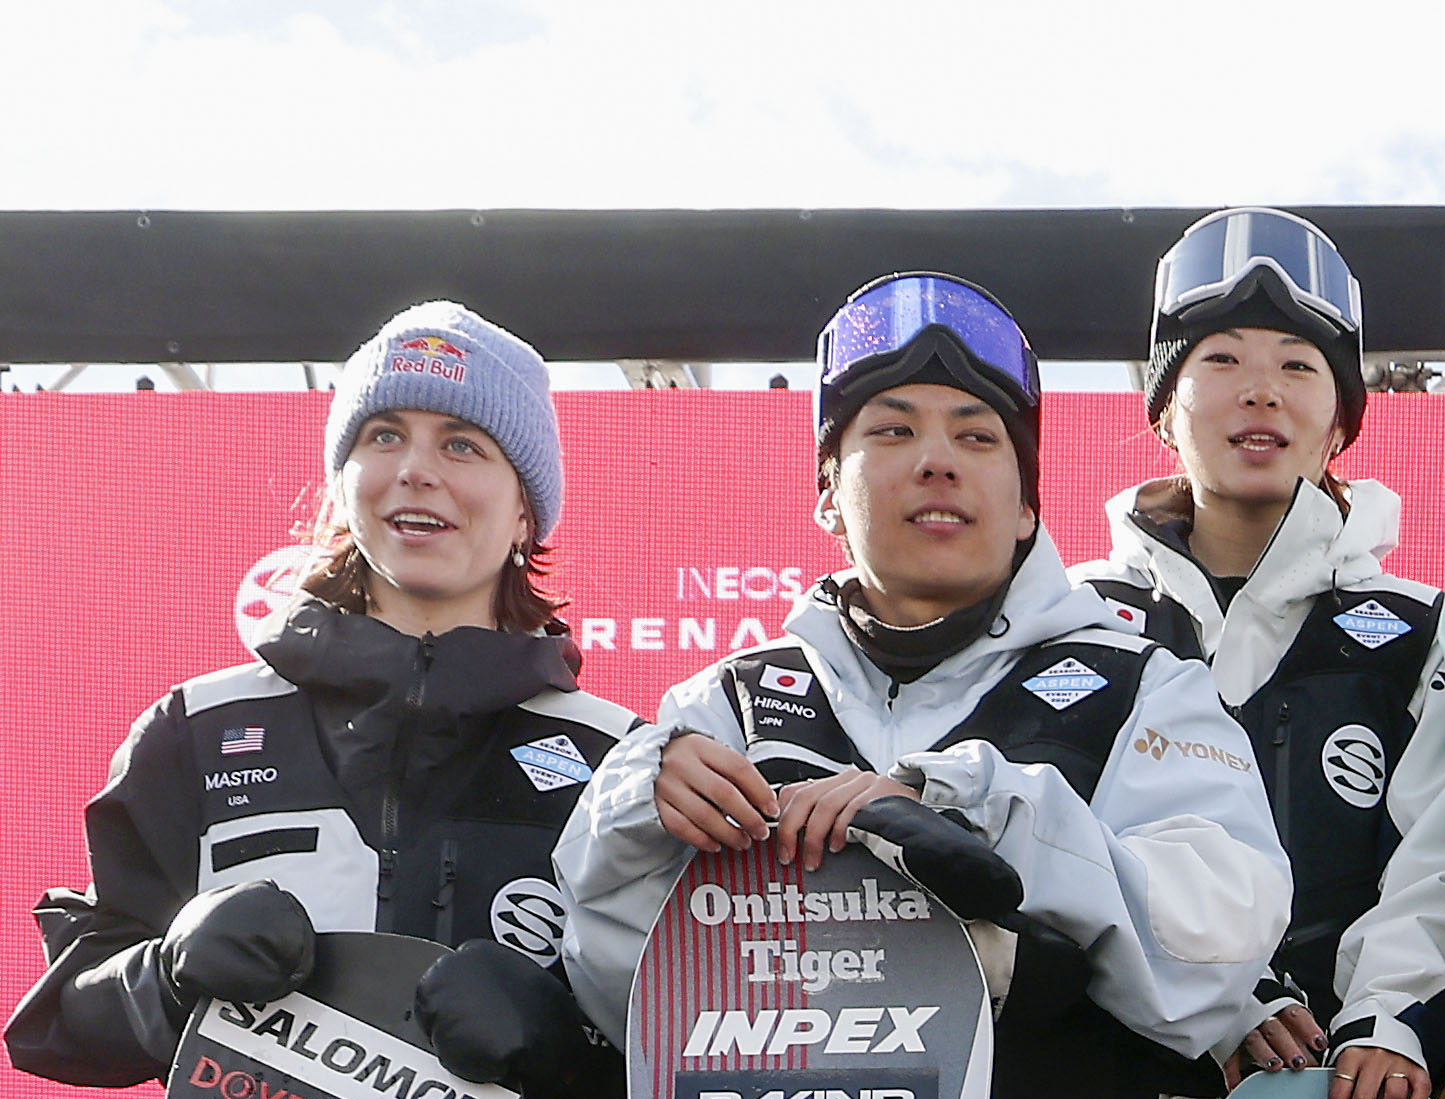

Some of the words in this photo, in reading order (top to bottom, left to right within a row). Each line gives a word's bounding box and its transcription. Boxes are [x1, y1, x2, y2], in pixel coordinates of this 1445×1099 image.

[391, 355, 427, 374] Red
[429, 358, 467, 384] Bull
[676, 567, 801, 600] INEOS
[1346, 618, 1398, 631] ASPEN
[1035, 678, 1095, 688] ASPEN
[754, 695, 816, 720] HIRANO
[759, 716, 783, 728] JPN
[523, 750, 582, 776] ASPEN
[205, 768, 278, 791] MASTRO
[228, 795, 250, 806] USA
[689, 877, 931, 925] Onitsuka
[740, 936, 886, 993] Tiger
[682, 1006, 941, 1057] INPEX
